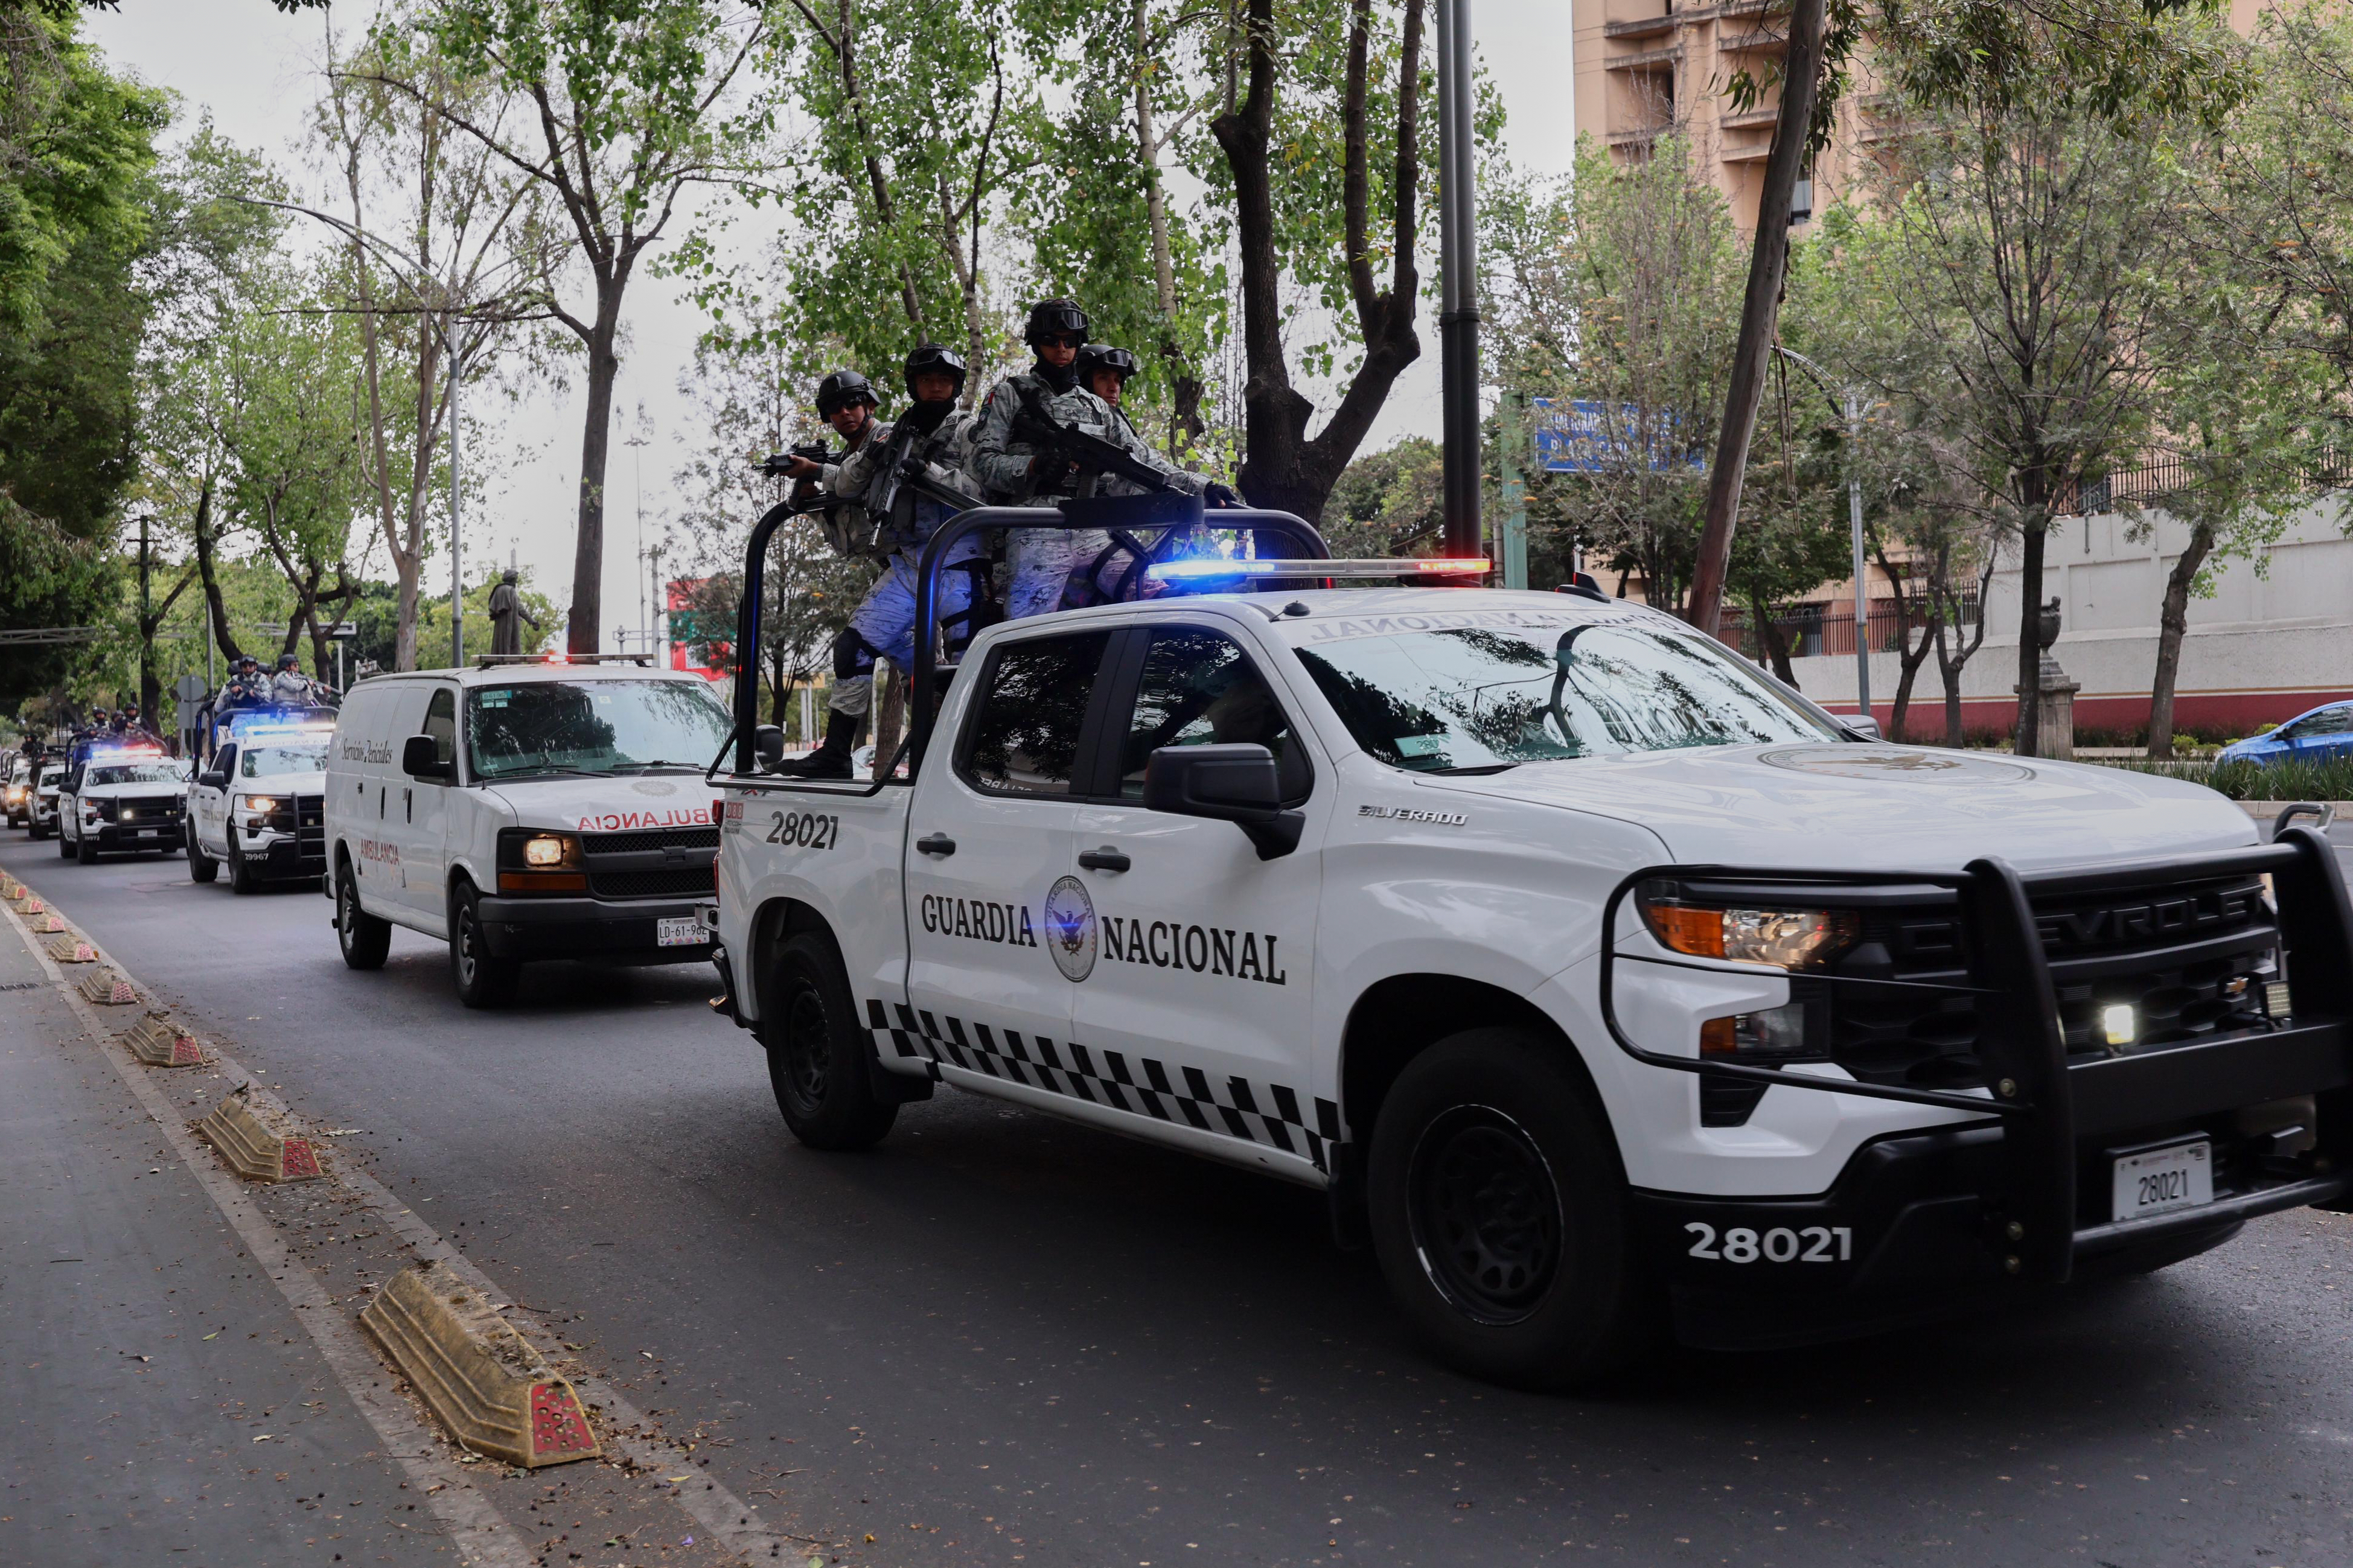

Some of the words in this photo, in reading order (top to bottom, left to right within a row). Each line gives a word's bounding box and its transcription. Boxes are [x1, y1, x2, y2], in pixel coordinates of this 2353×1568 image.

[342, 738, 365, 761] Servicios
[363, 739, 393, 764] Periciales
[727, 804, 742, 818] 088
[1358, 805, 1469, 826] SILVERADO
[765, 811, 839, 850] 28021
[244, 852, 269, 861] 29967
[360, 838, 400, 866] AMBULANCIA
[1047, 881, 1067, 917] GUARDIA
[1067, 881, 1092, 922] NACIONAL
[921, 893, 1038, 948] GUARDIA
[1100, 915, 1286, 986] NACIONAL
[2138, 1167, 2188, 1206] 28021
[1683, 1221, 1853, 1264] 28021
